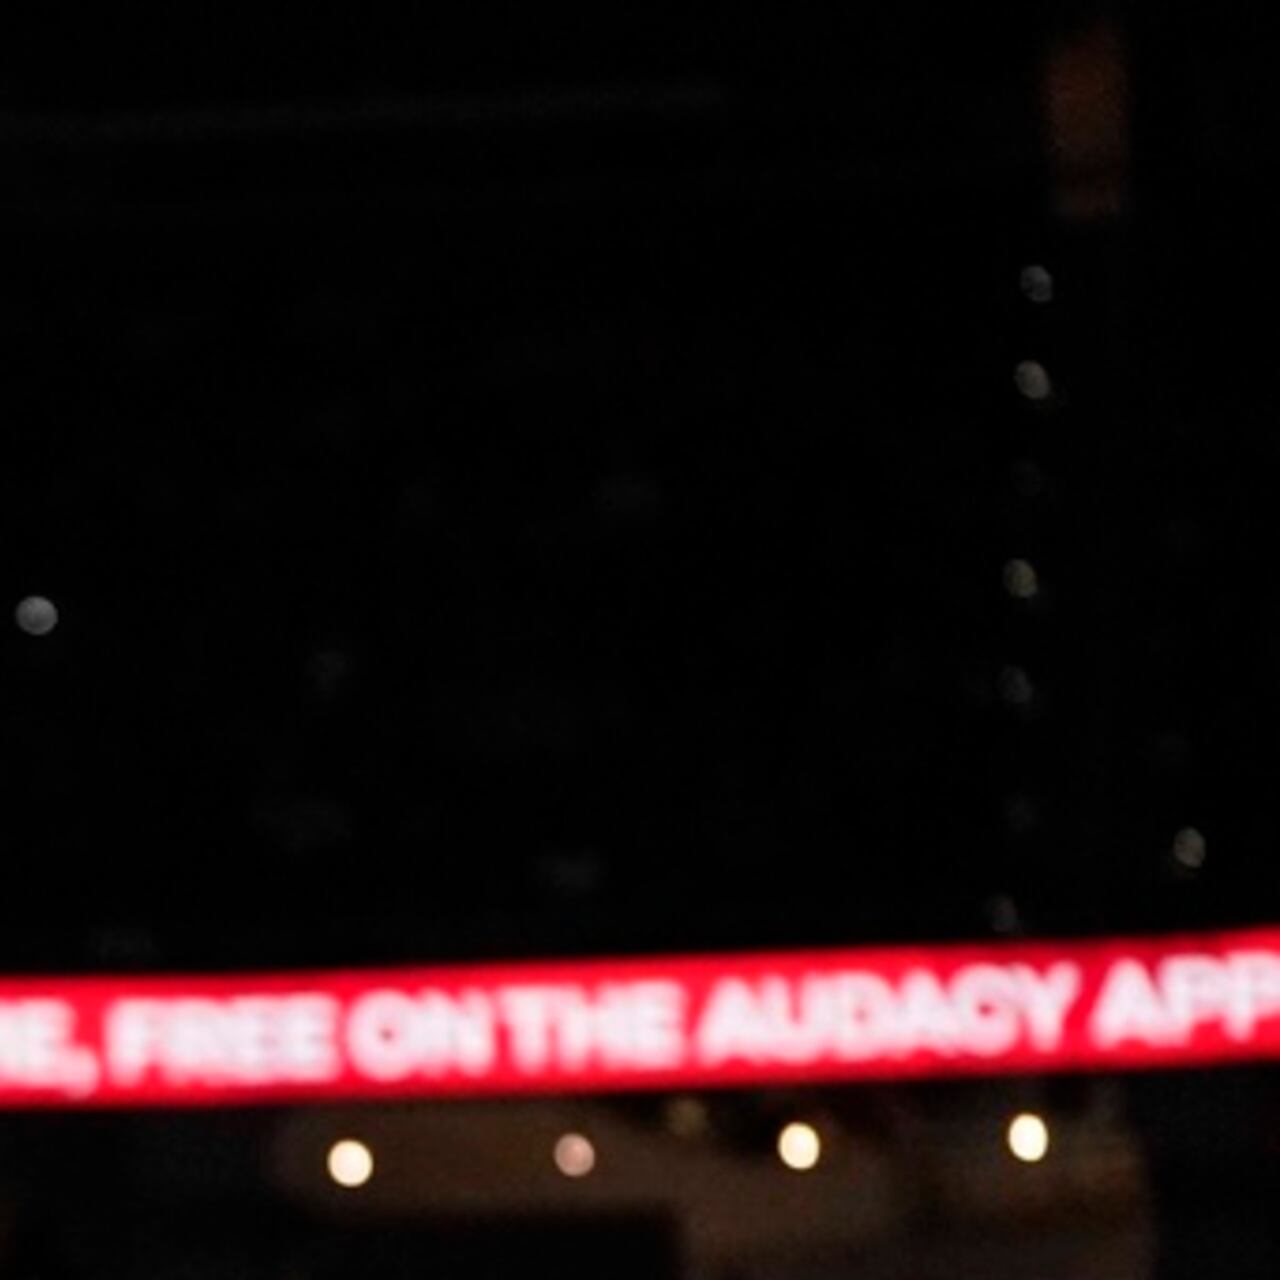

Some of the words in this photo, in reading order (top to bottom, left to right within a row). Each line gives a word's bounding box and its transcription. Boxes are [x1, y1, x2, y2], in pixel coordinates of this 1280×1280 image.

[102, 990, 338, 1086] FREE
[344, 988, 496, 1082] ON
[496, 978, 688, 1076] THE
[696, 962, 1082, 1066] AUDACY
